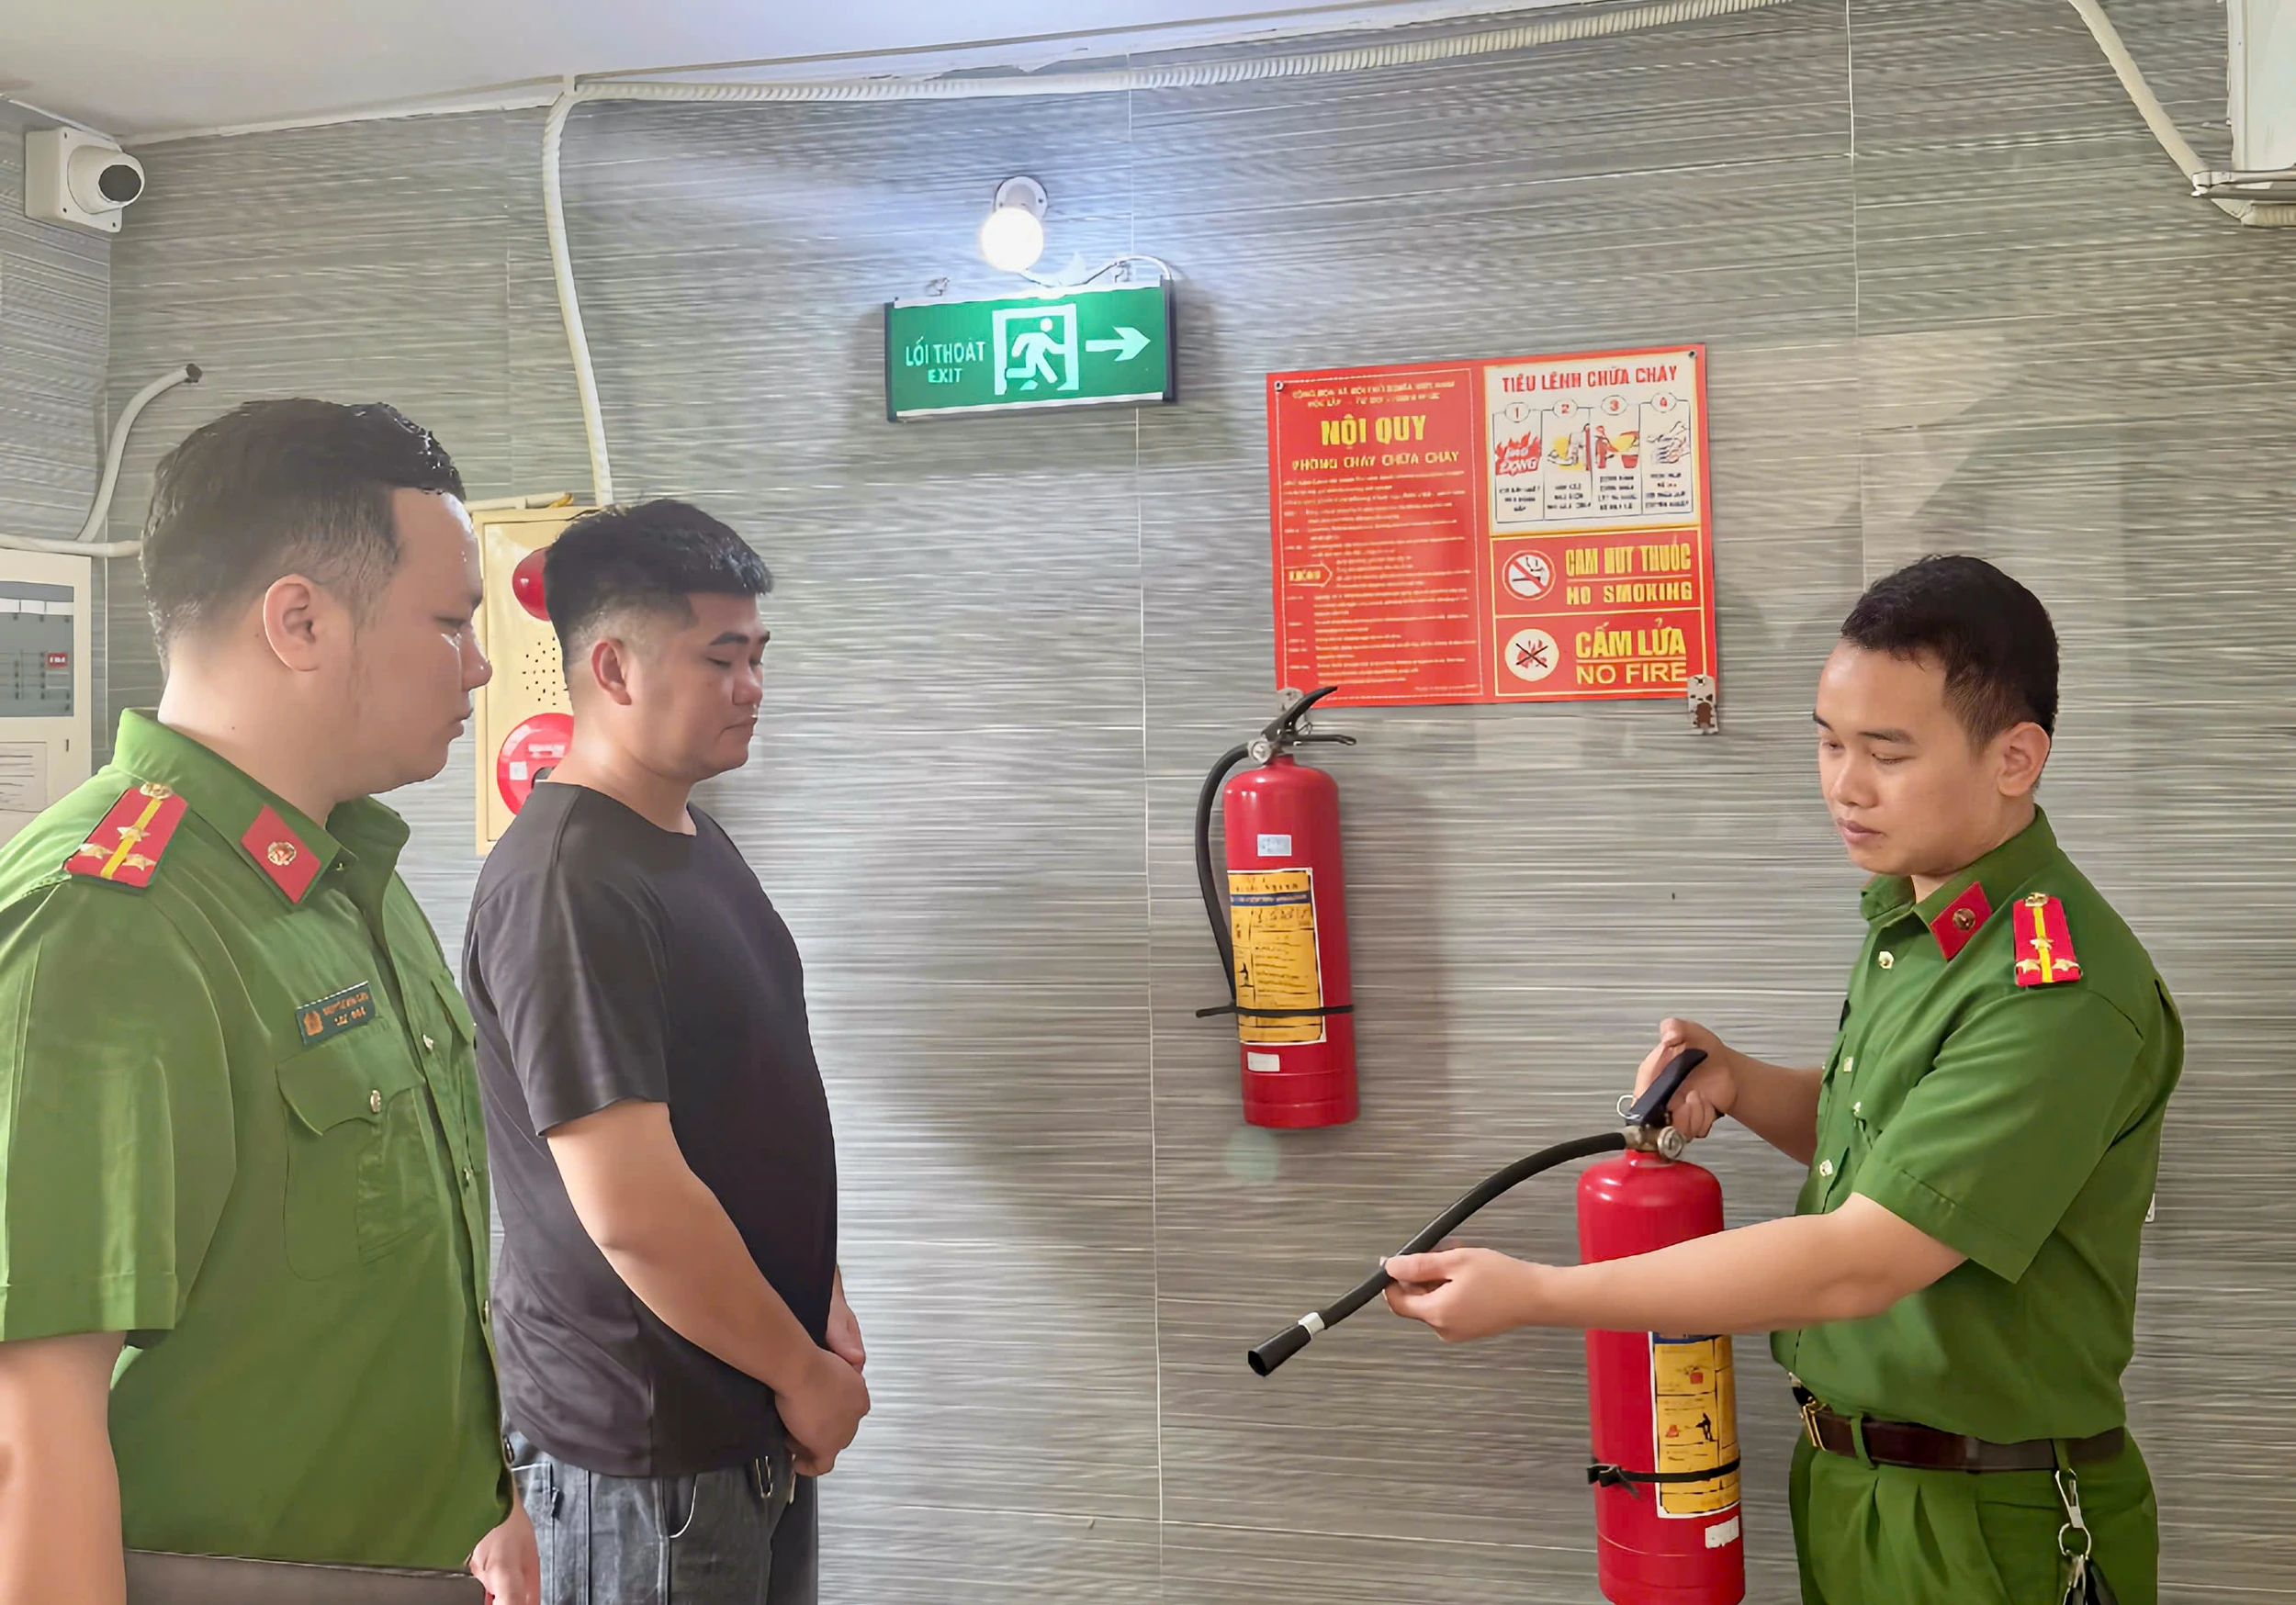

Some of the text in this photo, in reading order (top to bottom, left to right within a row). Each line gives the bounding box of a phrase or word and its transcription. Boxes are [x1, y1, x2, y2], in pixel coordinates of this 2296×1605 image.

[928, 368, 962, 383] EXIT
[1561, 404, 1570, 413] 2
[1610, 400, 1619, 411] 3
[1321, 413, 1426, 450] NỘI QUY
[1566, 581, 1693, 605] NO SMOKING
[1576, 617, 1686, 658] CẤM LỬA
[1576, 662, 1687, 684] NO FIRE
